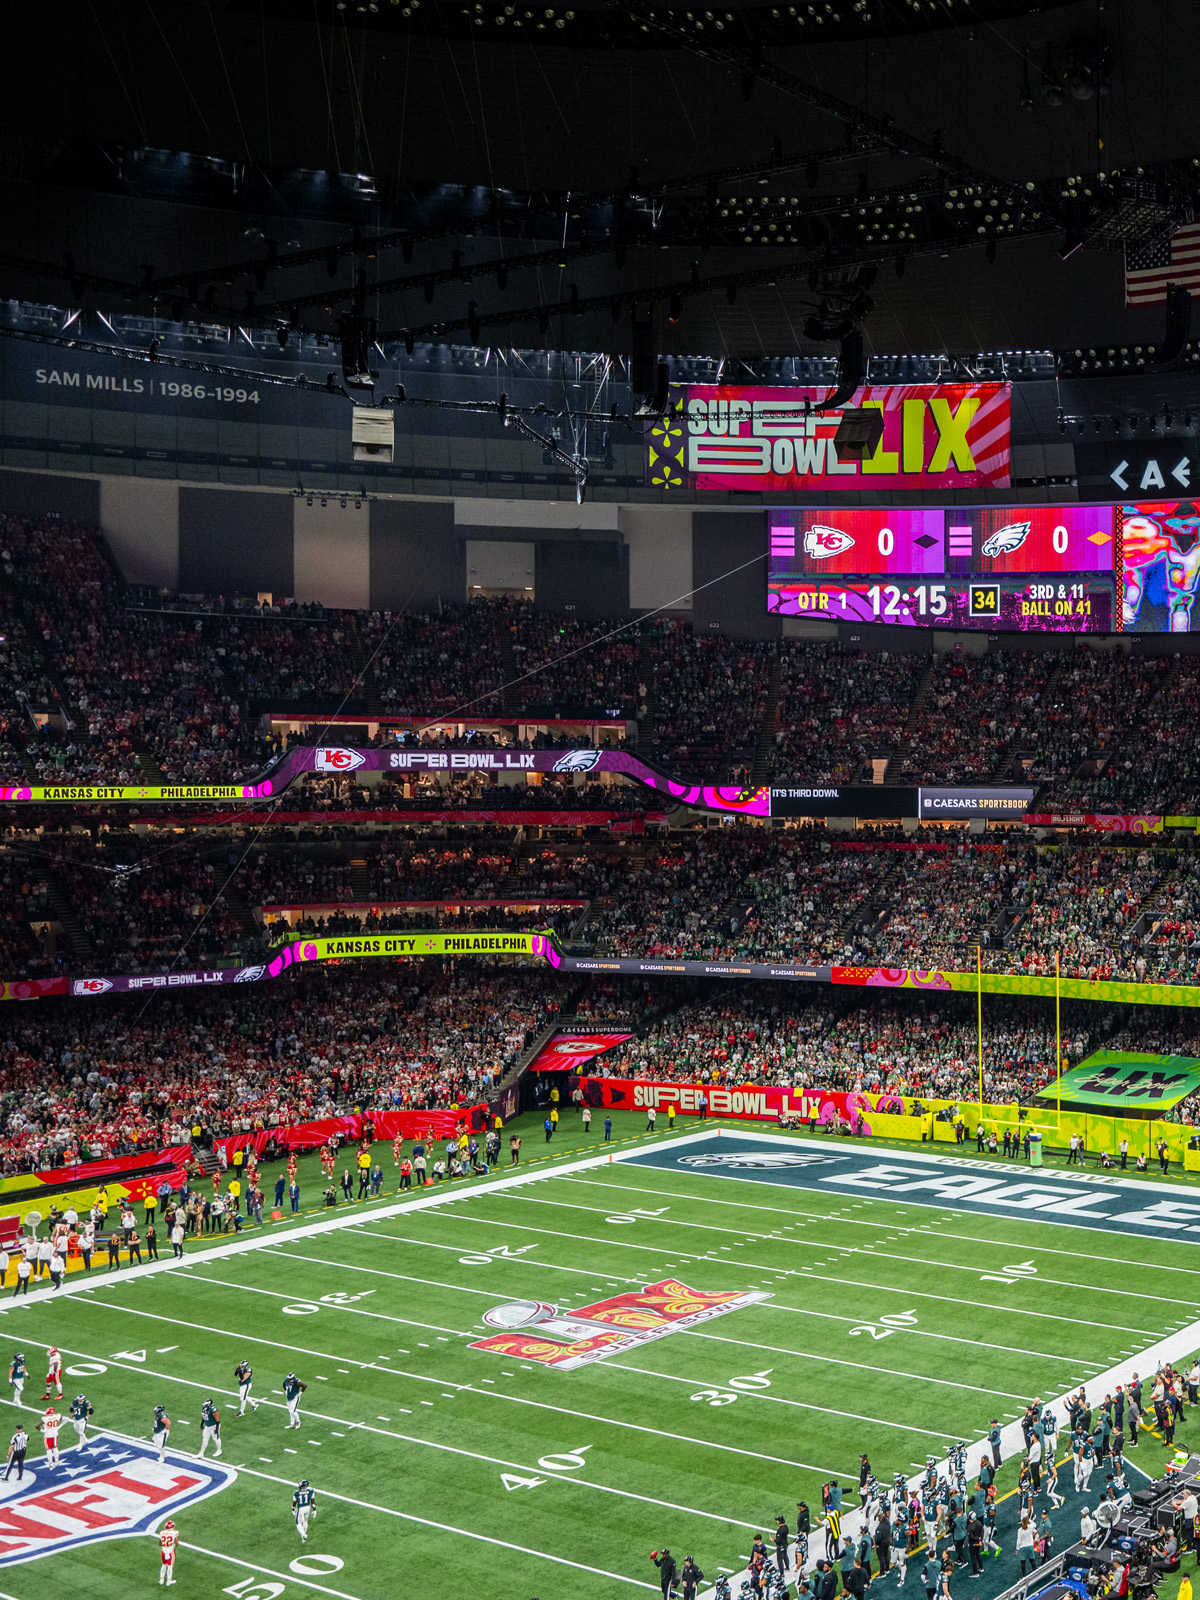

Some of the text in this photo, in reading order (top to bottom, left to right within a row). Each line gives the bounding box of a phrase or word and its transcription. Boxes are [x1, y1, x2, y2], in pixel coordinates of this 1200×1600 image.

[35, 369, 261, 404] SAM MILLS 1986-1994
[861, 397, 981, 475] LIX
[688, 437, 857, 475] BOWL
[877, 528, 894, 556] 0
[1052, 526, 1069, 554] 0
[798, 592, 847, 610] QTR 1
[867, 585, 947, 616] 12:15
[974, 591, 996, 610] 34
[1029, 584, 1084, 600] 3RD & 11
[1021, 600, 1091, 616] BALL ON 41
[390, 753, 535, 768] SUPER BOWL LIX
[43, 787, 237, 799] KANSAS CITY PHILADELPHIA
[772, 788, 840, 798] IT'S THIRD DOWN.
[933, 799, 1028, 809] CAESARS SPORTSBOOK
[326, 937, 527, 954] KANSAS CITY PHILADELPHIA
[128, 971, 223, 988] SUPER BOWL LIX
[1078, 1066, 1190, 1098] LIX
[633, 1084, 821, 1118] SUPER BOWL LIX
[935, 1157, 1123, 1184] CHOOSE LOVE
[980, 1265, 1037, 1284] 10
[580, 1298, 750, 1360] SUPER BOWL
[848, 1314, 918, 1340] 20
[690, 1376, 771, 1406] 30
[46, 1419, 58, 1428] 90
[500, 1453, 587, 1491] 40
[298, 1493, 309, 1504] 11
[160, 1535, 173, 1548] 22
